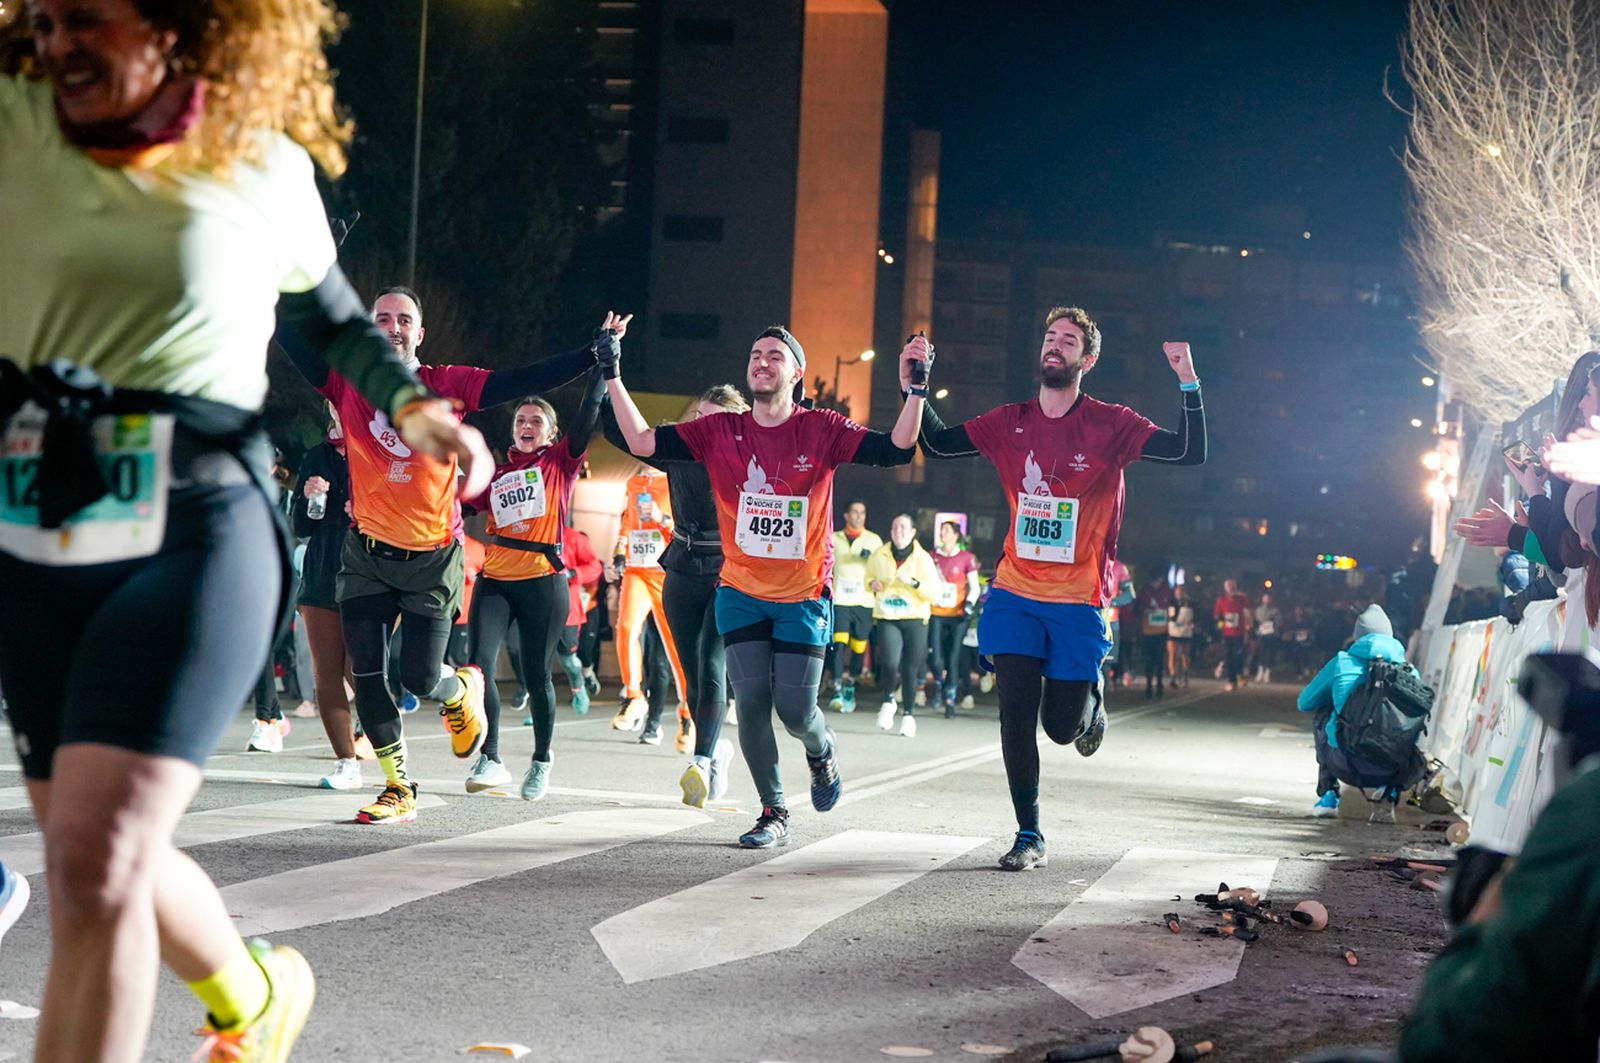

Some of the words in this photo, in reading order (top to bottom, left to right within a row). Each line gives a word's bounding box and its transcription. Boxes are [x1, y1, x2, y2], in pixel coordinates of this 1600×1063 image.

[379, 431, 396, 448] 43
[499, 486, 536, 508] 3602
[754, 500, 773, 509] NOCHE
[745, 507, 759, 515] SAN
[759, 507, 783, 517] ANTÓN
[749, 516, 794, 537] 4923
[1024, 517, 1062, 540] 7863
